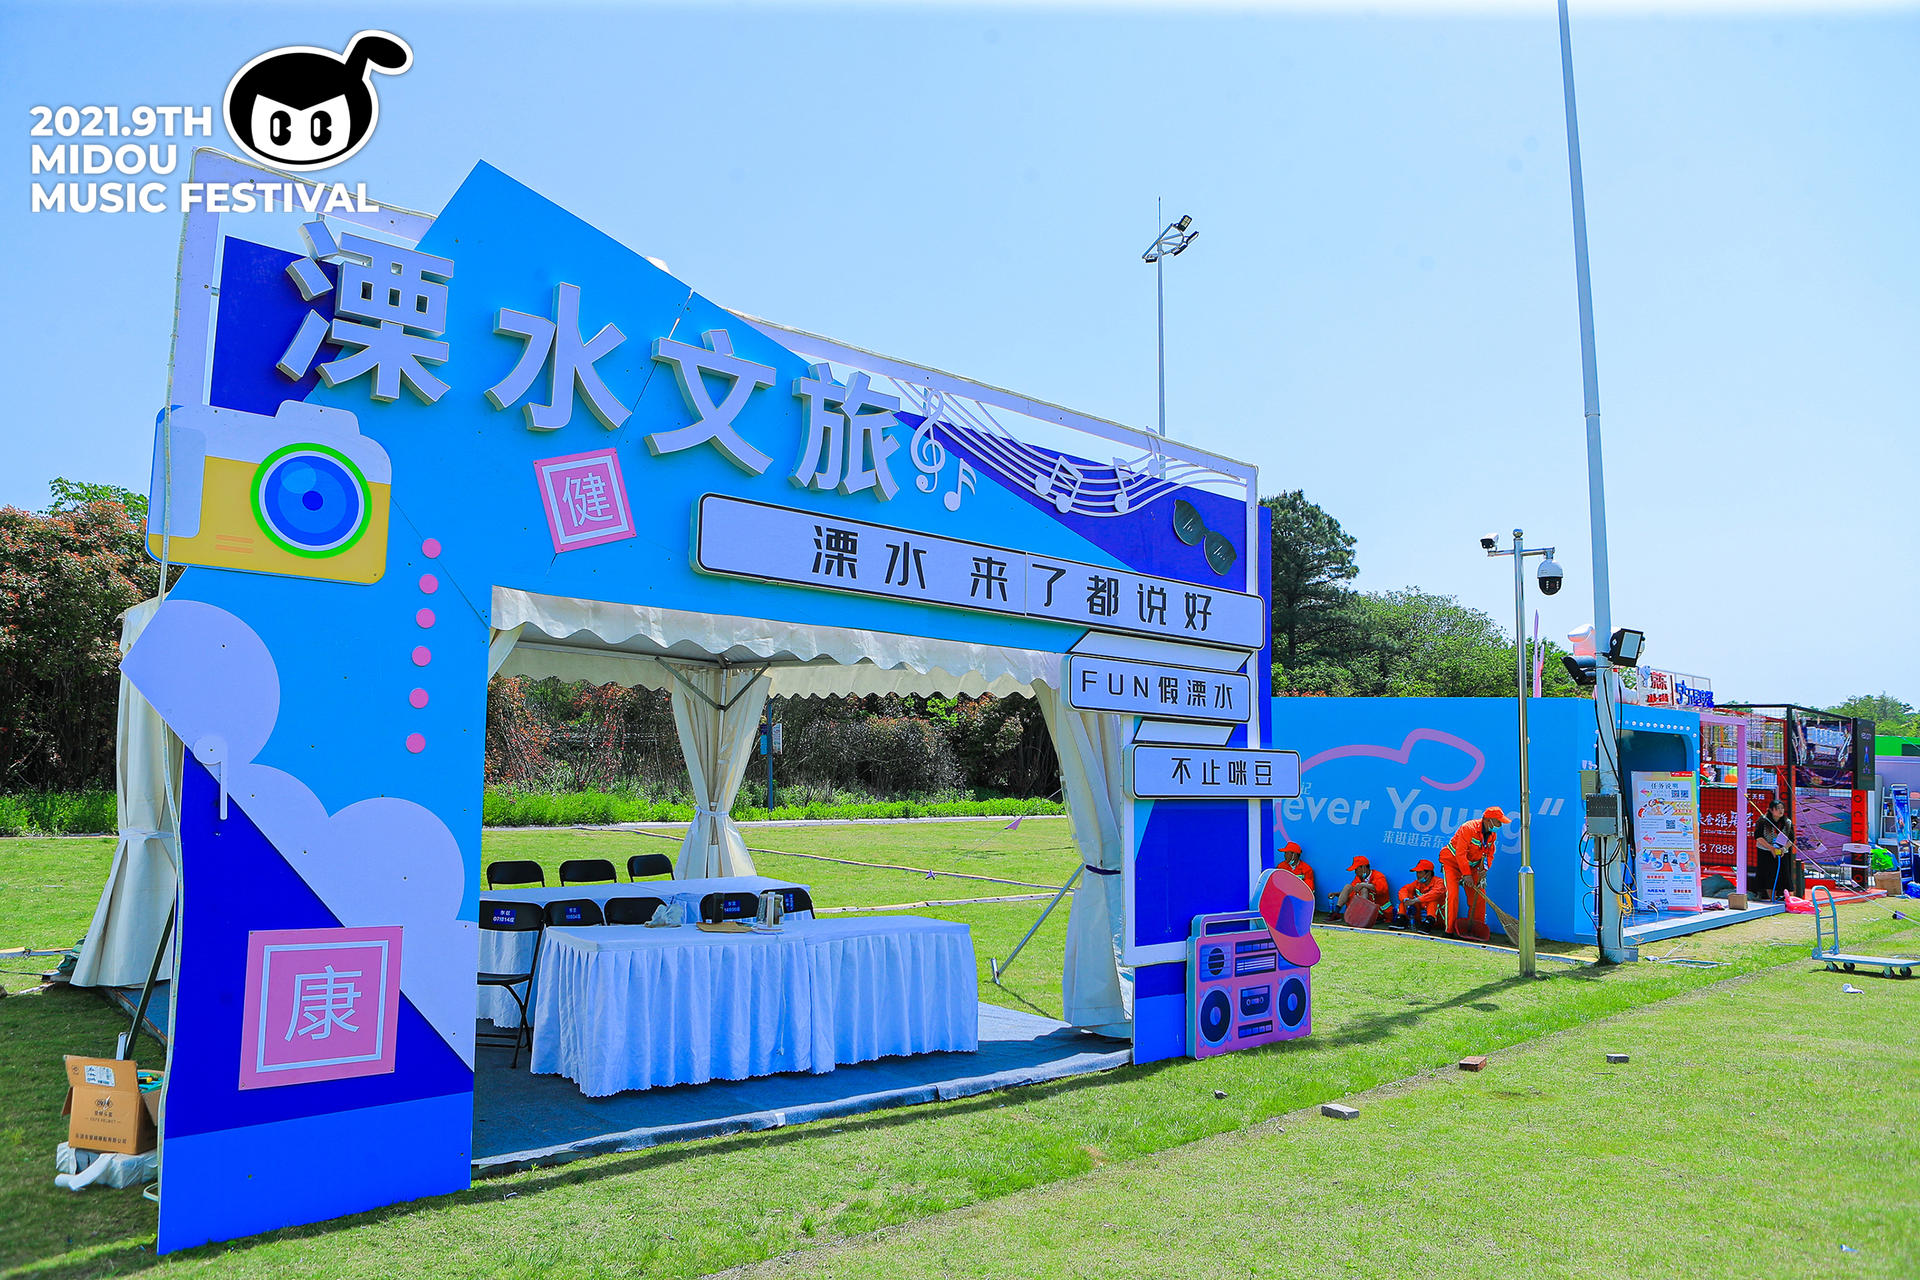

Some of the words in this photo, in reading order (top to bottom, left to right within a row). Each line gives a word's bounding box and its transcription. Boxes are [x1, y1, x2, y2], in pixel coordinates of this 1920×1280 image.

[276, 219, 901, 502] 溧水文旅
[562, 472, 614, 527] 健
[1171, 757, 1273, 786] 不止咪豆
[284, 965, 363, 1042] 康
